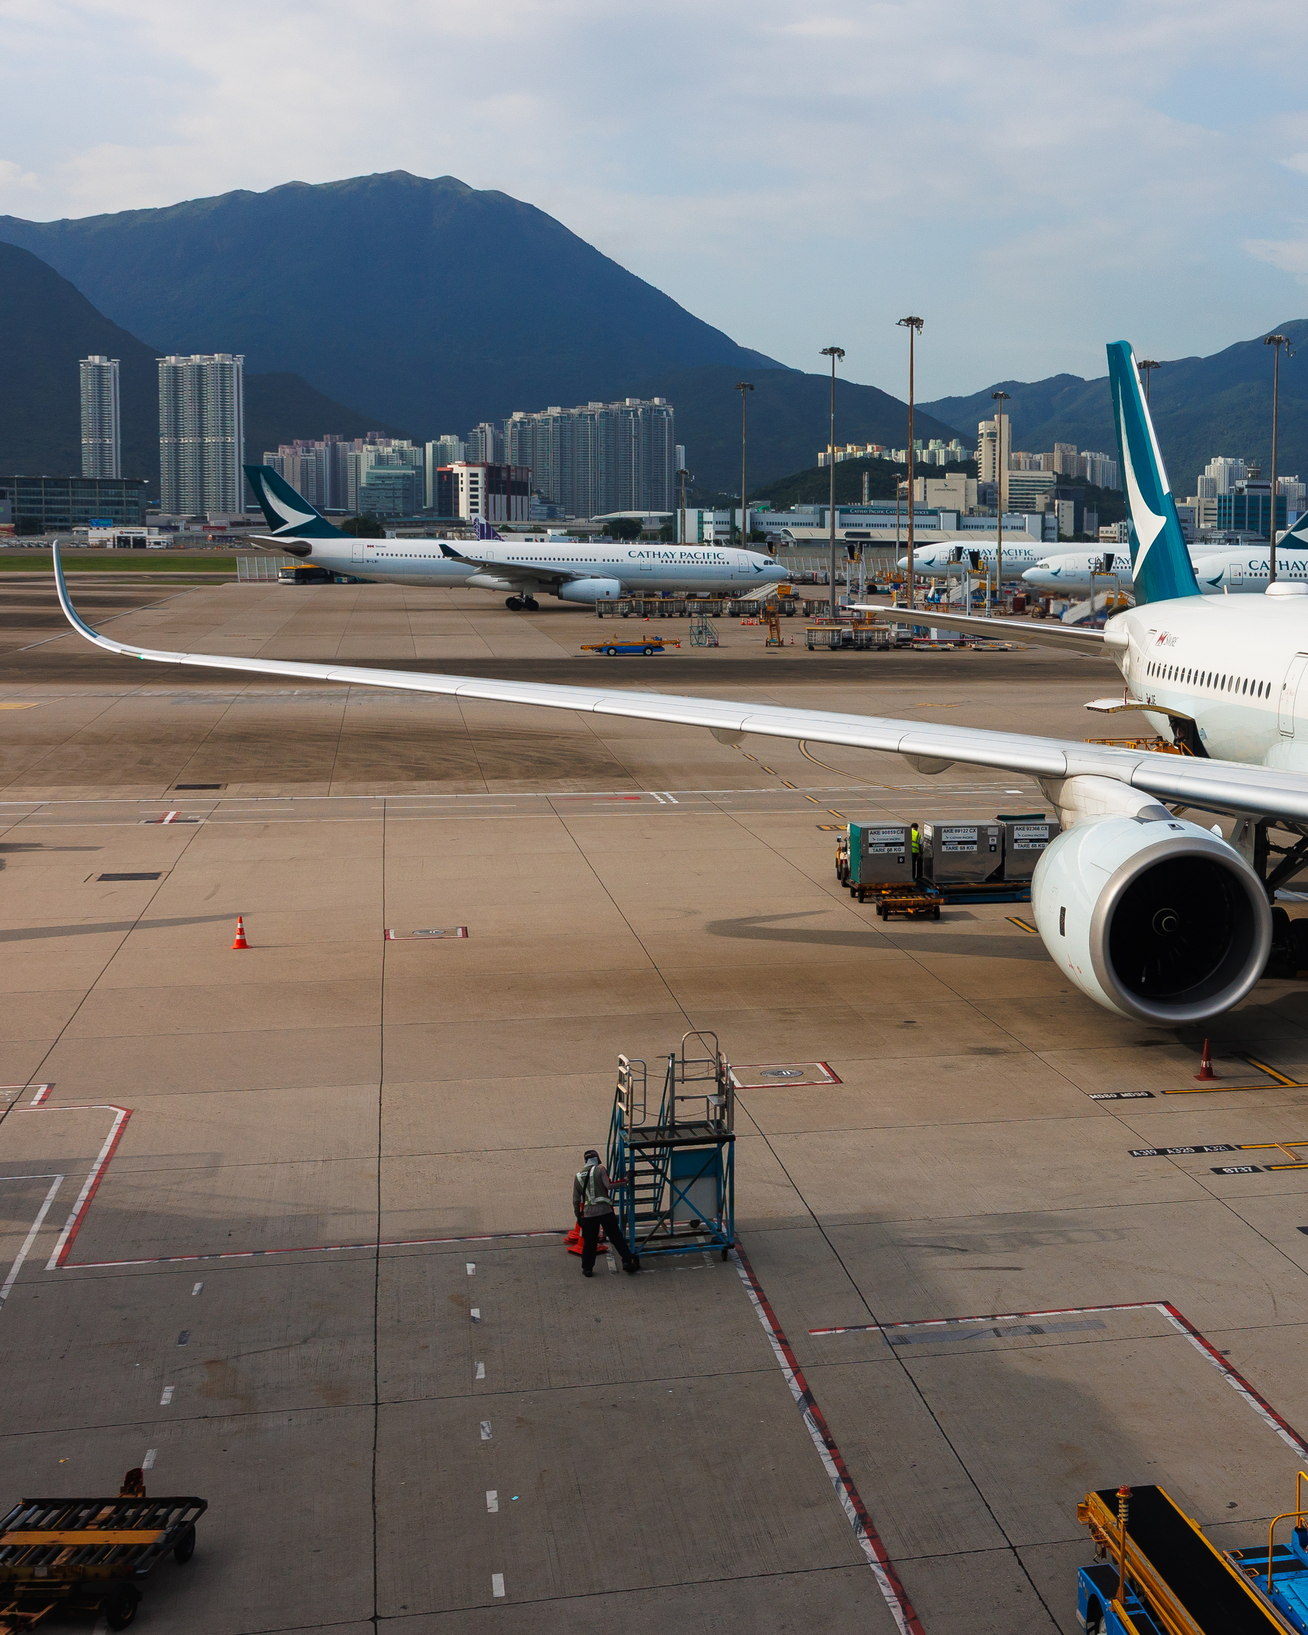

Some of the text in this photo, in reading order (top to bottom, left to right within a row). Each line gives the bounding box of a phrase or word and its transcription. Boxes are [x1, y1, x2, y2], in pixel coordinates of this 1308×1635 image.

[628, 550, 724, 560] CATHAY PACIFIC
[1248, 560, 1308, 570] CAHAY
